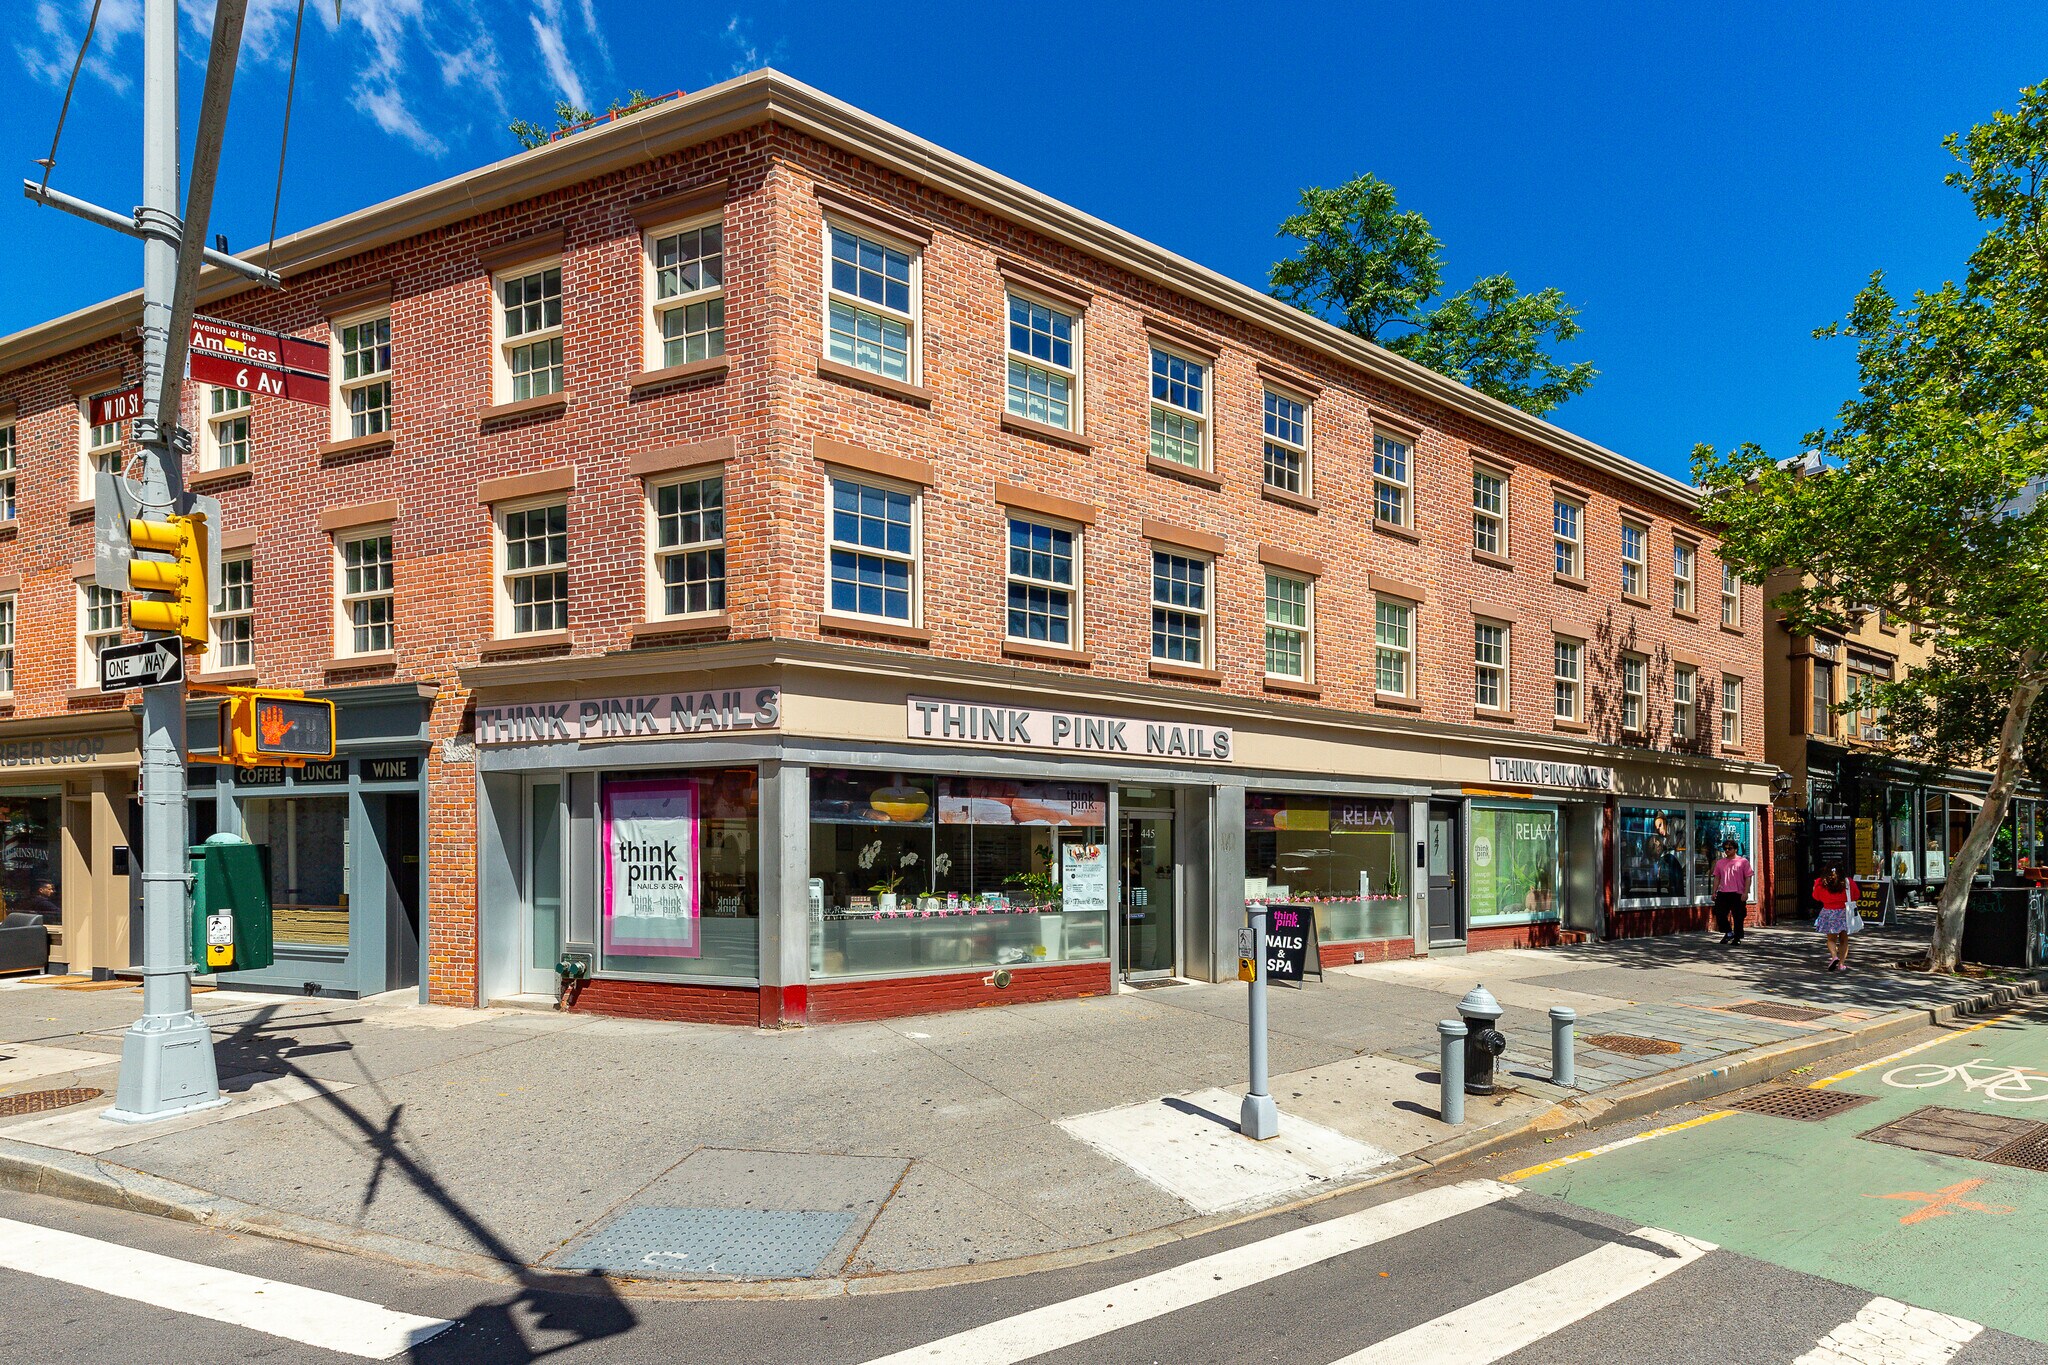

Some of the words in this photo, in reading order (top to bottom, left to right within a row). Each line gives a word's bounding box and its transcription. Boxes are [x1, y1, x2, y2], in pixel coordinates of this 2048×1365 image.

[193, 321, 227, 336] Avenue
[230, 330, 239, 338] of
[242, 332, 256, 342] the
[236, 368, 248, 388] 6
[257, 372, 283, 395] Av
[104, 400, 112, 420] W
[115, 396, 126, 418] 10
[129, 393, 139, 414] St
[109, 659, 130, 678] ONE
[144, 653, 167, 672] WAY
[476, 703, 570, 741] THINK
[580, 698, 660, 738] PINK
[670, 689, 779, 732] NAILS
[916, 702, 1031, 744] THINK
[1052, 715, 1127, 750] PINK
[1147, 724, 1230, 758] NAILS
[50, 737, 104, 764] SHOP
[239, 767, 281, 784] COFFEE
[301, 765, 341, 781] LUNCH
[373, 761, 407, 778] WINE
[1496, 758, 1539, 783] THINK
[1541, 763, 1573, 786] PINK
[1067, 789, 1094, 801] think
[1071, 799, 1097, 815] pink.
[1343, 804, 1394, 825] RELAX
[1140, 828, 1155, 838] 445
[1516, 823, 1551, 840] RELAX
[620, 840, 677, 862] think
[628, 862, 683, 896] pink.
[632, 894, 652, 904] think
[660, 895, 681, 906] think
[1857, 900, 1881, 908] COPY
[1274, 911, 1298, 921] think
[1275, 918, 1299, 931] pink.
[1266, 935, 1302, 949] NAILS
[1277, 949, 1285, 958] &
[1267, 958, 1292, 973] SPA
